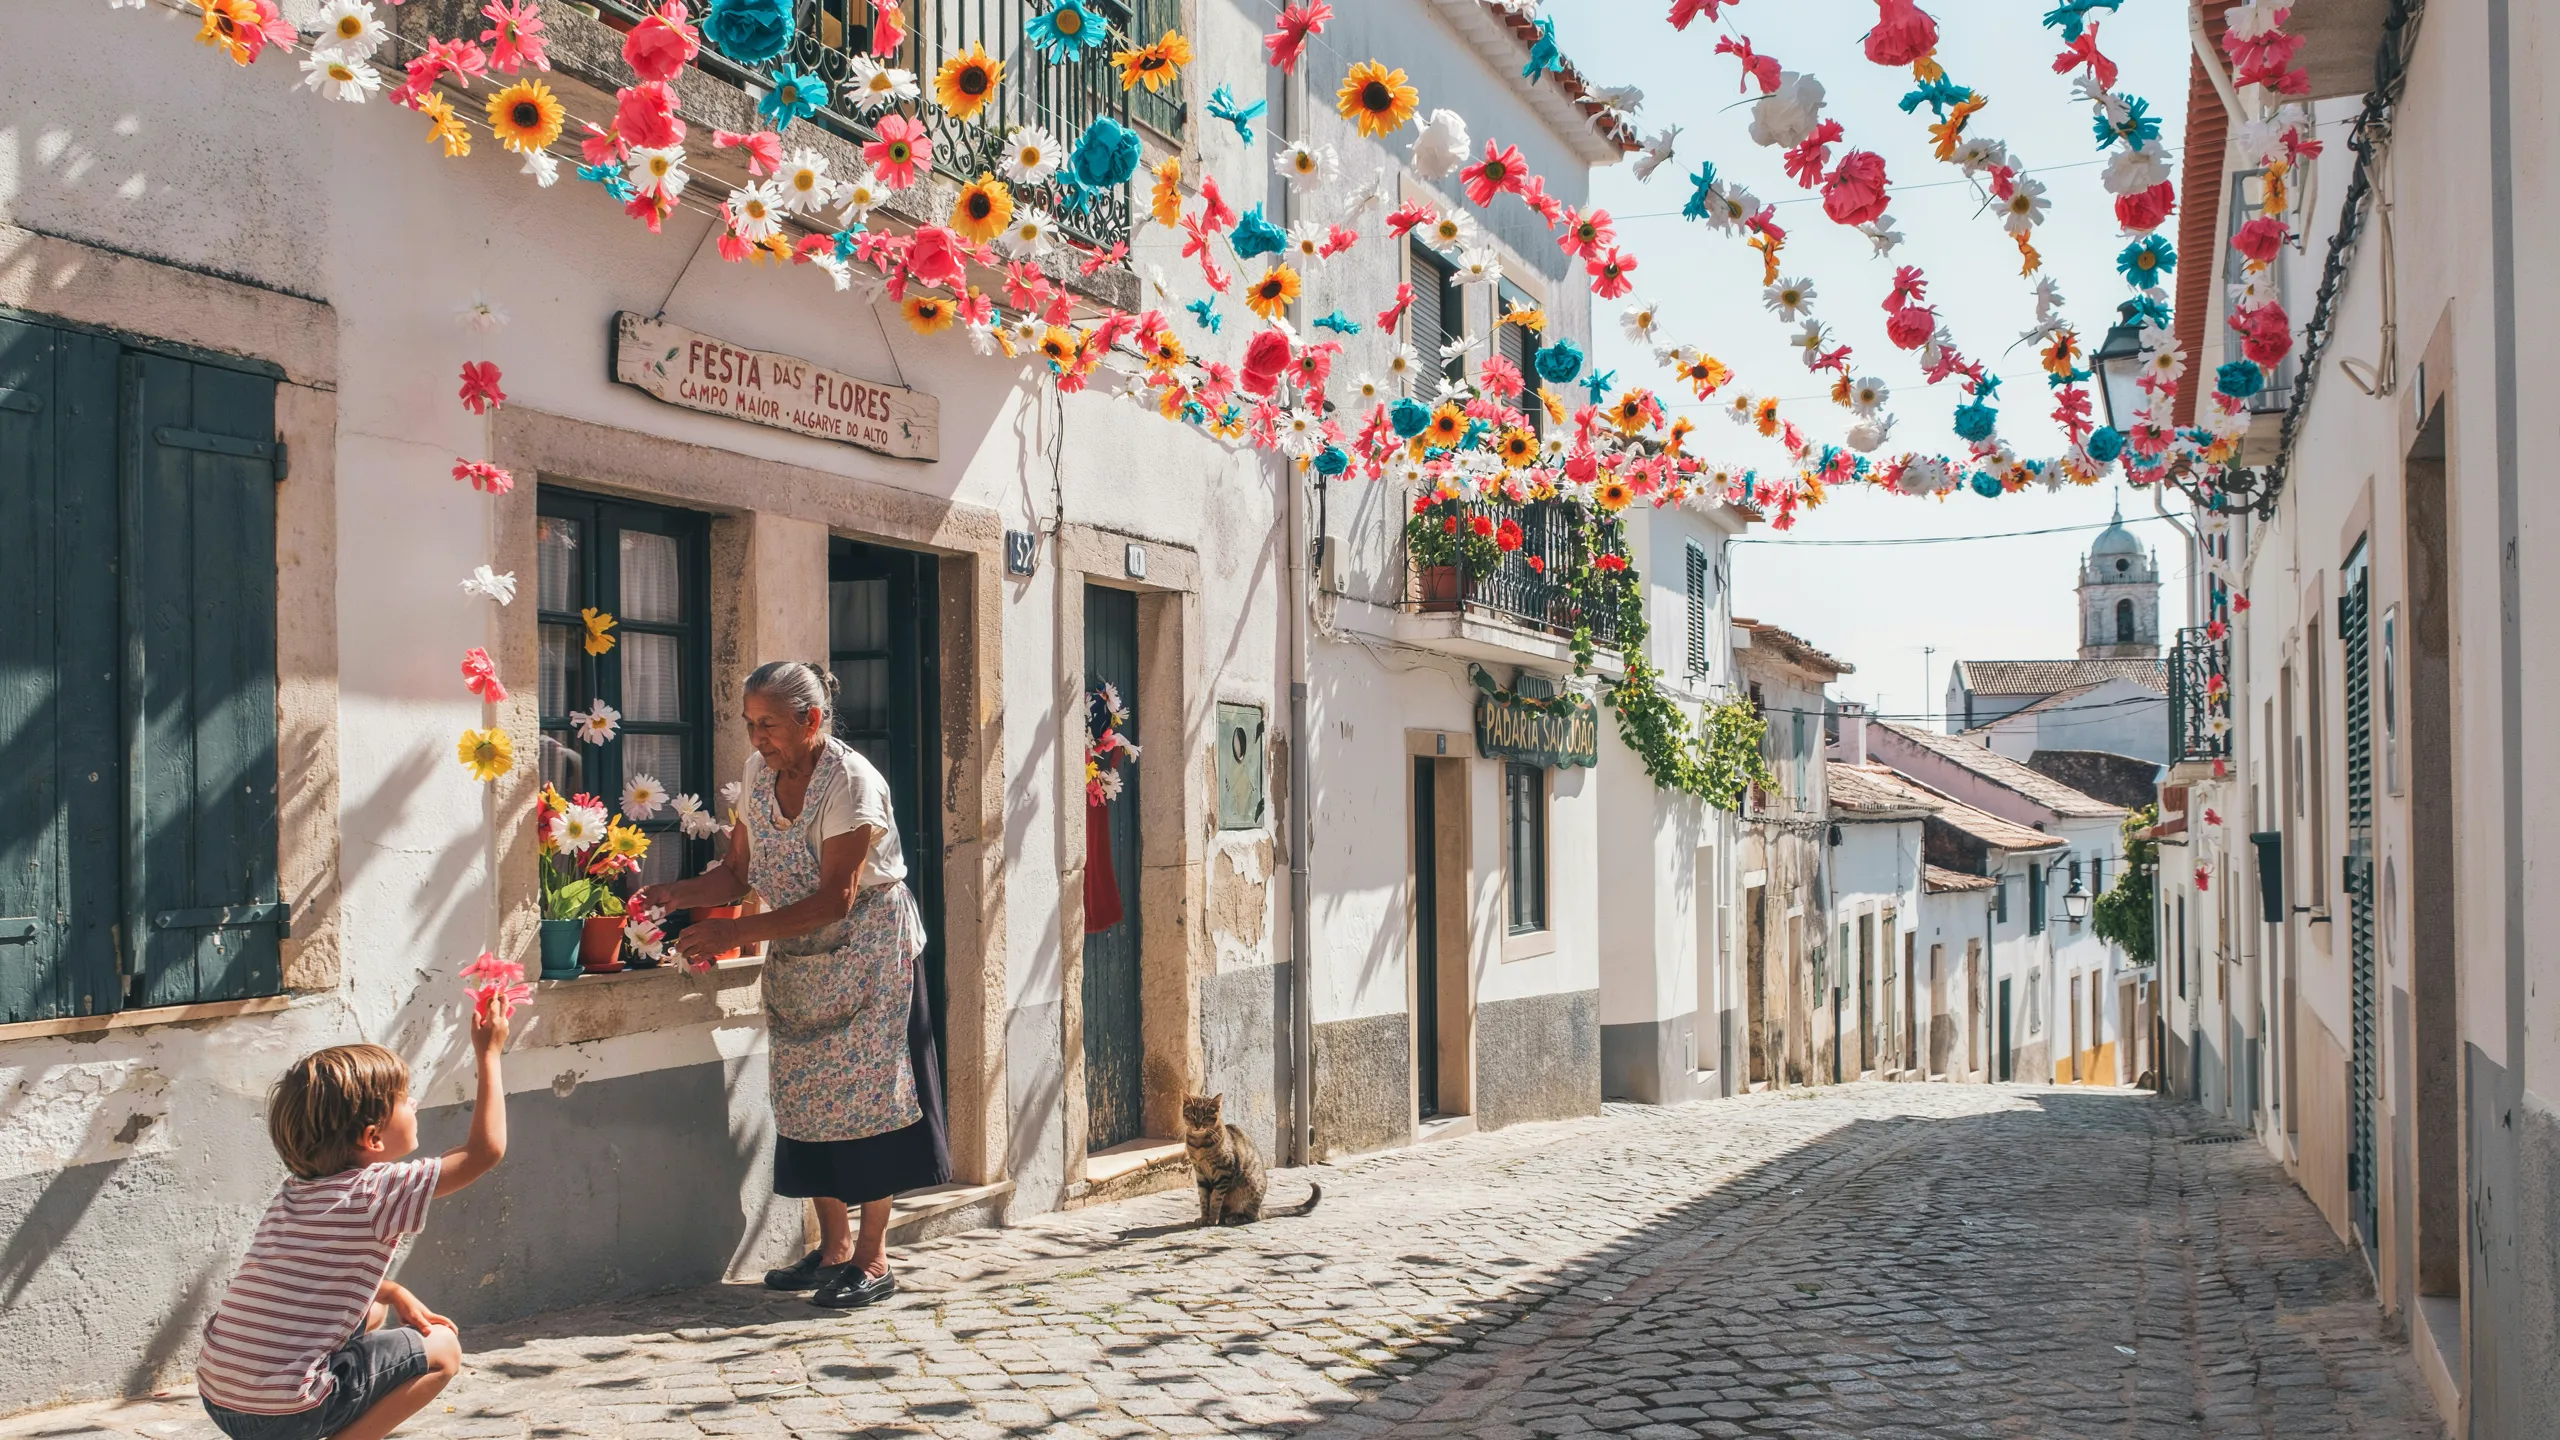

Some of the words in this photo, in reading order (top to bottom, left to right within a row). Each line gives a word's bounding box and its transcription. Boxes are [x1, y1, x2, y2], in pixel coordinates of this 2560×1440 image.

[680, 378, 728, 407] CAMPO
[735, 391, 779, 420] MAIOR
[847, 421, 859, 437] DO
[863, 426, 888, 445] ALTO
[689, 340, 761, 391] FESTA
[773, 362, 802, 390] DAS
[814, 373, 891, 423] FLORES
[1486, 702, 1540, 752] PADARIA
